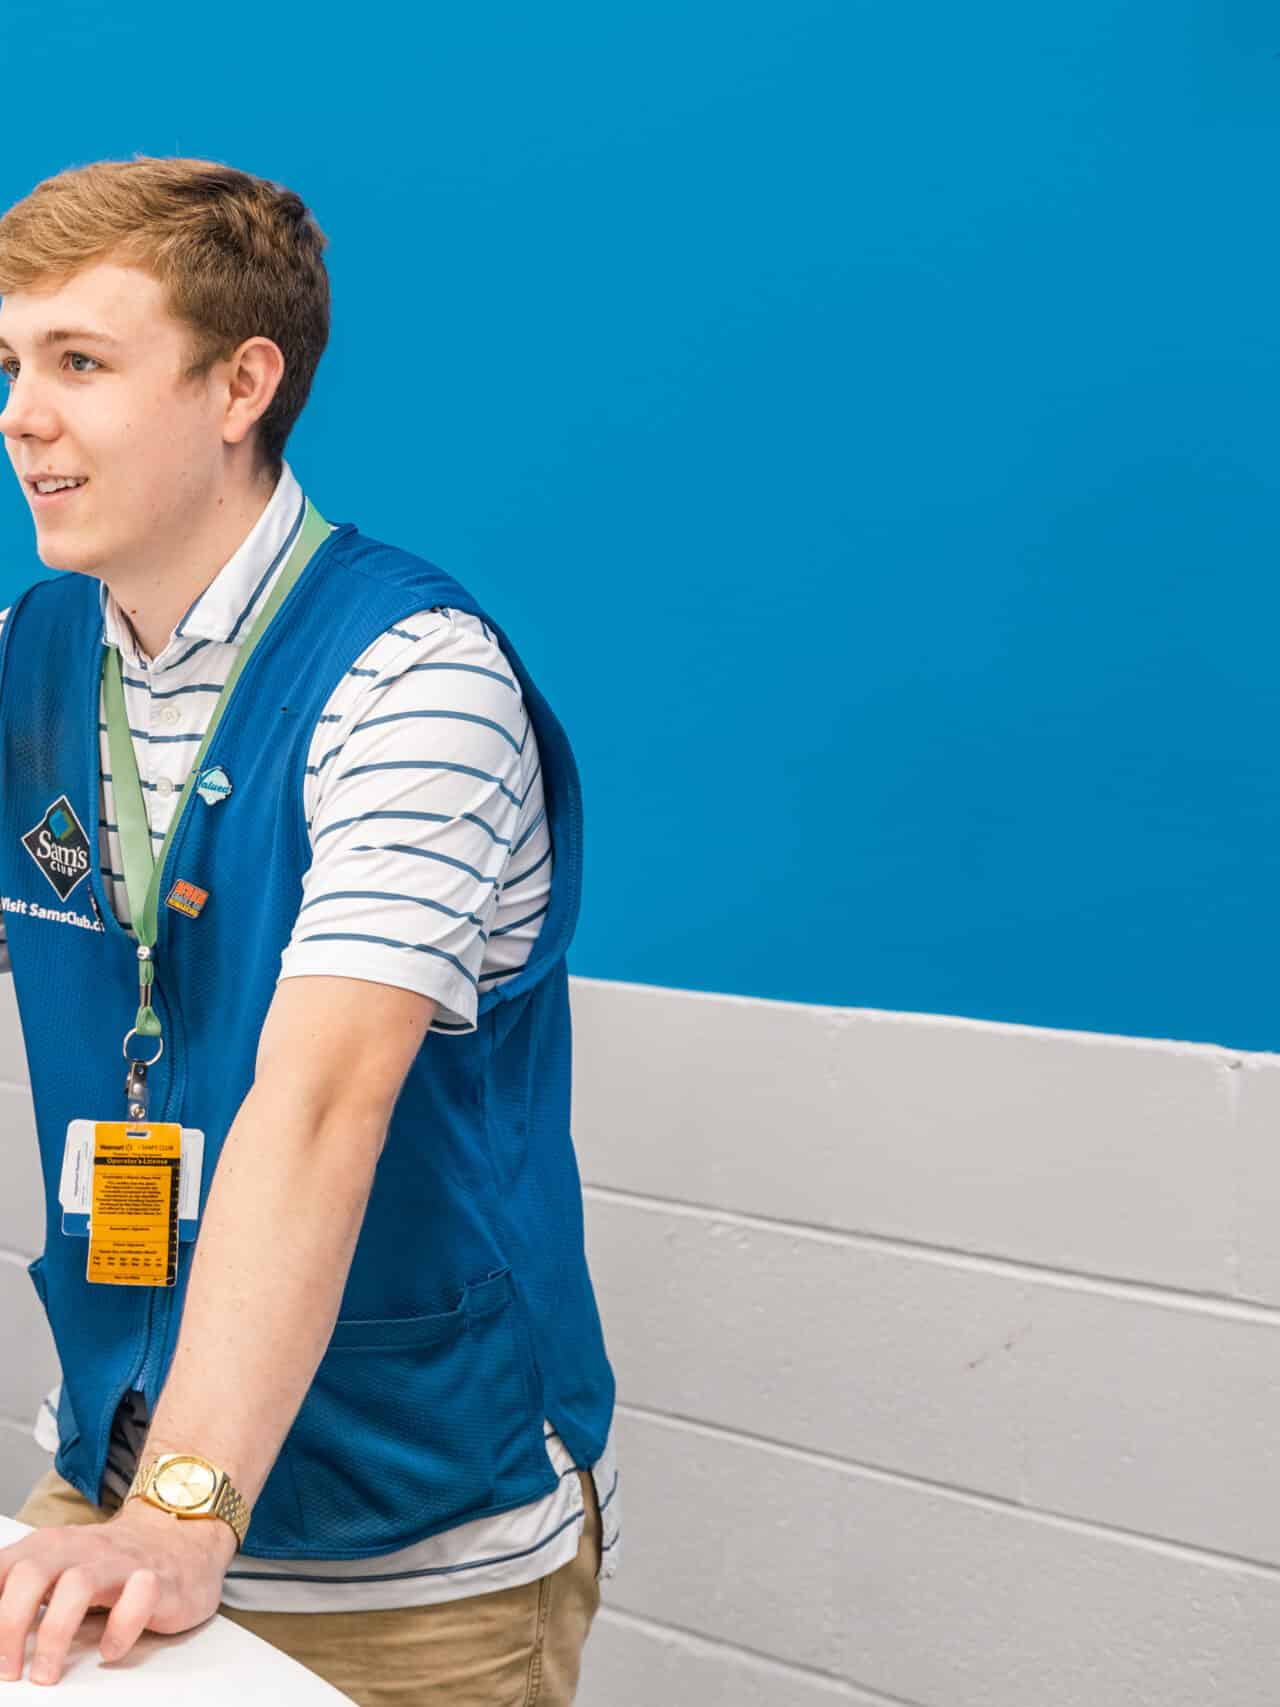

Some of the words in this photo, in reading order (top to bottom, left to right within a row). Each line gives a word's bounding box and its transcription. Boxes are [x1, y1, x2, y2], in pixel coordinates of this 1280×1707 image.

[36, 829, 88, 870] Sam's
[49, 861, 74, 877] CLUB
[1, 896, 28, 914] Visit
[28, 903, 106, 932] SamsClub.c
